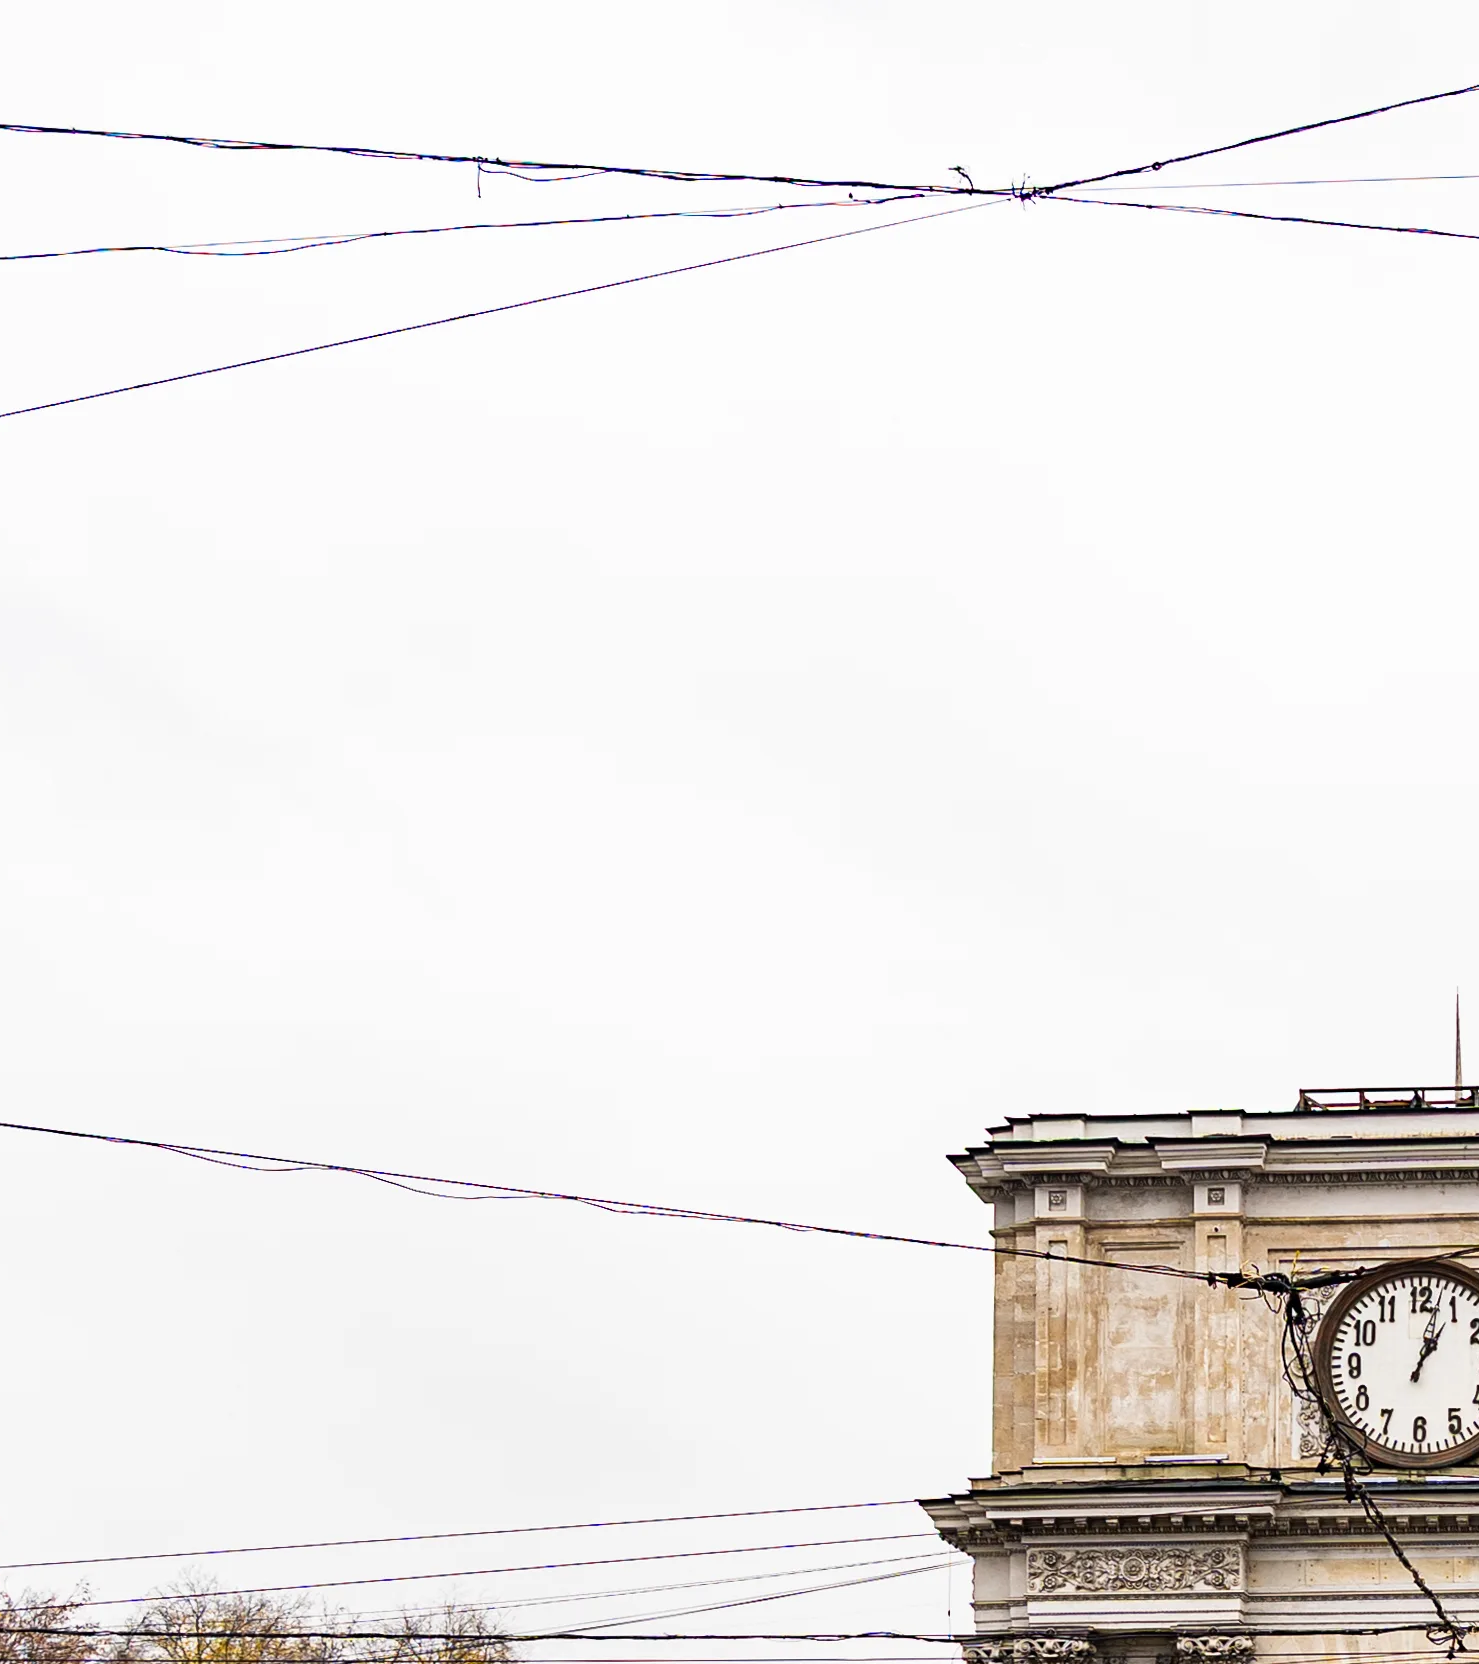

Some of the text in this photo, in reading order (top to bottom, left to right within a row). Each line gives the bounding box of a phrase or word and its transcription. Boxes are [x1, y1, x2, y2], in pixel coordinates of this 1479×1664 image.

[1379, 1296, 1395, 1323] 11
[1410, 1286, 1433, 1313] 12
[1449, 1296, 1458, 1323] 1
[1354, 1319, 1376, 1346] 10
[1348, 1353, 1361, 1379] 9
[1356, 1385, 1369, 1411] 8
[1380, 1408, 1394, 1435] 7
[1413, 1416, 1427, 1442] 6
[1448, 1408, 1462, 1435] 5
